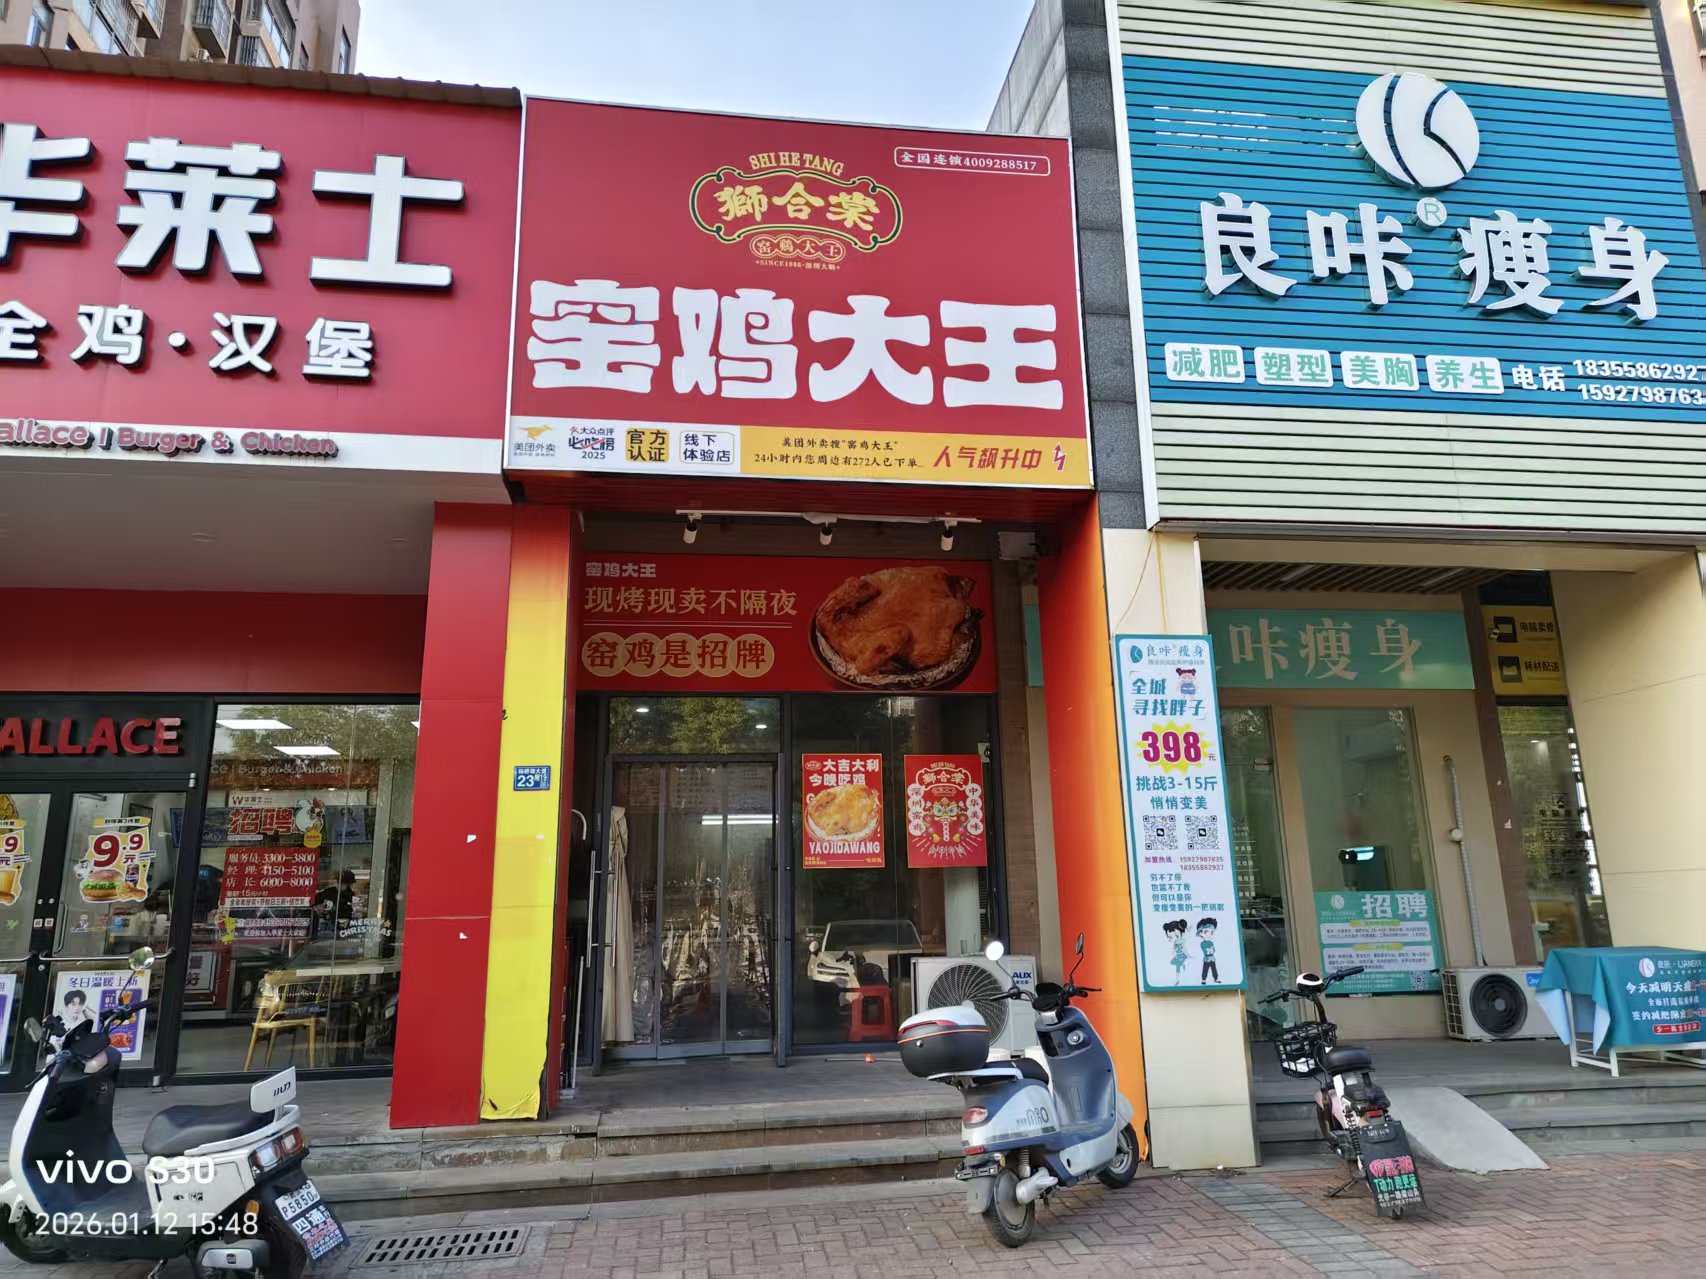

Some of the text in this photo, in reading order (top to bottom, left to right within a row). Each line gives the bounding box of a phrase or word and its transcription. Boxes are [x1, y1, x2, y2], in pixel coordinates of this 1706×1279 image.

[749, 152, 845, 177] SHI HE TANG
[900, 151, 1037, 171] 全国连锁4009288517
[1200, 191, 1669, 321] 良咔瘦身
[526, 279, 1064, 410] 窑鸡大王
[1172, 347, 1566, 392] 减肥 塑型 美胸 养生 电话
[1577, 383, 1706, 405] 1592798763
[580, 427, 615, 436] 大众点评
[627, 430, 667, 446] 官方
[117, 427, 202, 455] Burger
[210, 431, 230, 449] &
[240, 432, 338, 455] Chicken
[513, 442, 556, 453] 美团外卖
[568, 436, 615, 452] 必吃榜
[684, 433, 717, 447] 线下
[581, 451, 606, 460] 2025
[627, 446, 667, 462] 认证
[683, 448, 731, 463] 体验店
[586, 562, 656, 578] 窑鸡大王
[584, 586, 798, 616] 现烤现卖不隔夜
[586, 638, 767, 670] 窑鸡是招牌
[1216, 617, 1422, 681] 咔瘦身
[1131, 678, 1167, 695] 全城
[1132, 699, 1206, 716] 寻找胖子
[0, 717, 182, 754] ALLACE
[1141, 731, 1202, 762] 398
[823, 759, 880, 772] 大吉大利
[517, 775, 535, 787] 23
[809, 773, 866, 787] 今晚吃鸡
[1136, 776, 1218, 792] 挑战3-15斤
[1150, 796, 1208, 810] 悄悄变美
[228, 807, 293, 835] 招聘
[93, 833, 143, 867] 9.9
[809, 841, 880, 854] YAOJIDAWANG
[123, 854, 136, 864] 元
[1361, 893, 1428, 918] 招聘
[69, 976, 138, 988] 冬日温暖上新
